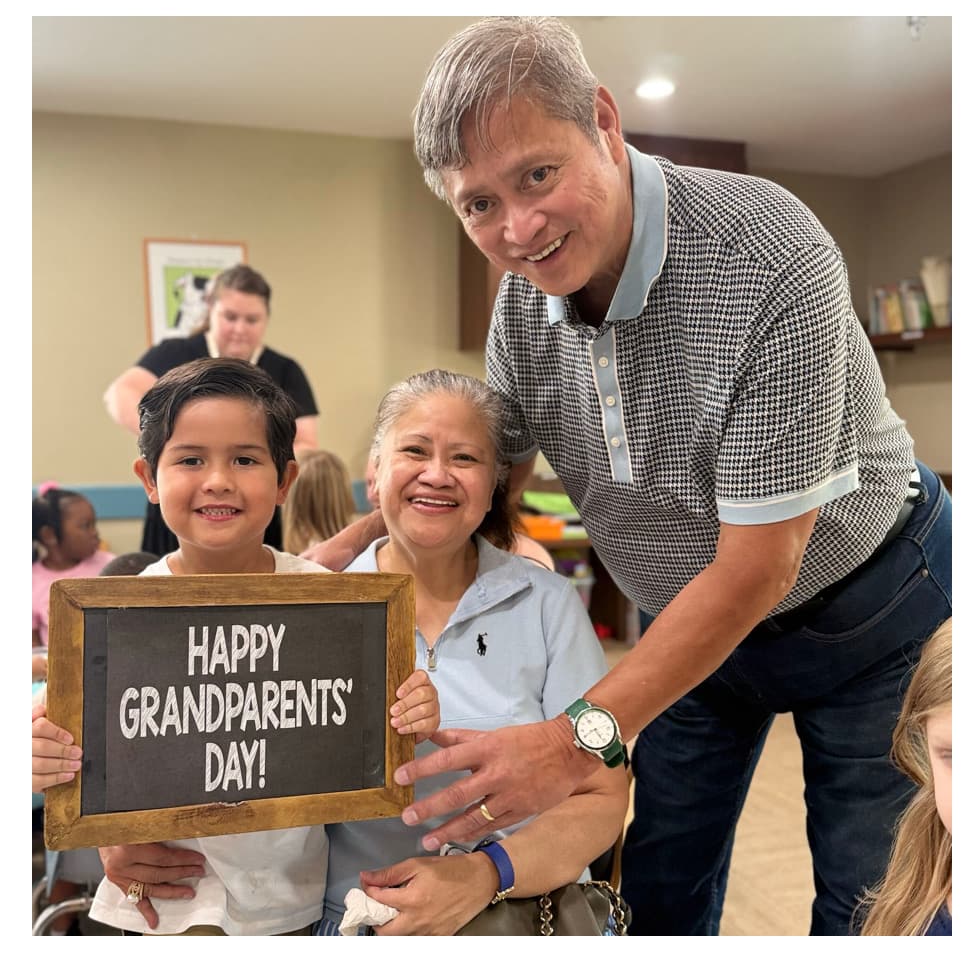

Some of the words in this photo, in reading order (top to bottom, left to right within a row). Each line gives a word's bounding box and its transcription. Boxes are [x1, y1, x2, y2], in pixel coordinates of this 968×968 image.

[187, 623, 286, 676] HAPPY
[119, 677, 353, 740] GRANDPARENTS'
[204, 738, 267, 793] DAY!
